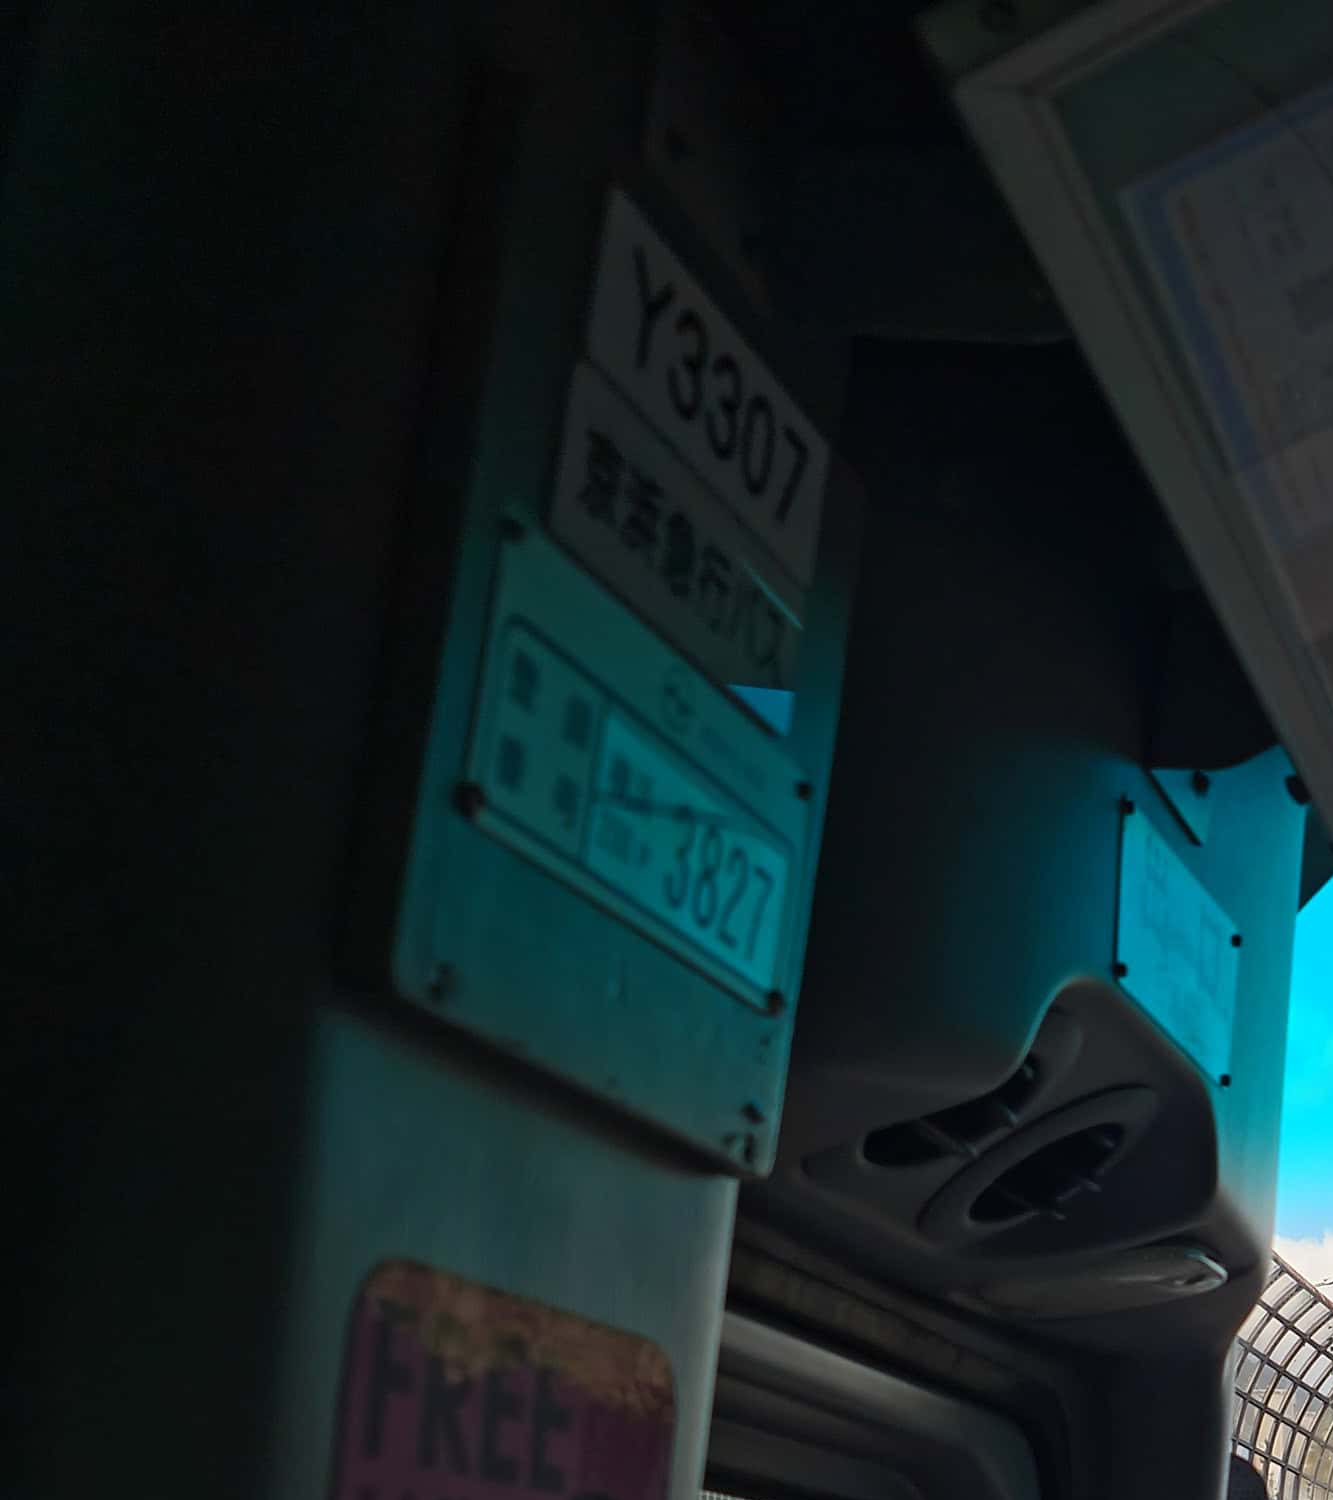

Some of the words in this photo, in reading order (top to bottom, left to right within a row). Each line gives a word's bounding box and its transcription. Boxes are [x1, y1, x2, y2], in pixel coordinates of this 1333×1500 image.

[632, 243, 813, 526] Y3307
[664, 808, 774, 964] 3827
[363, 1302, 572, 1492] FREE
